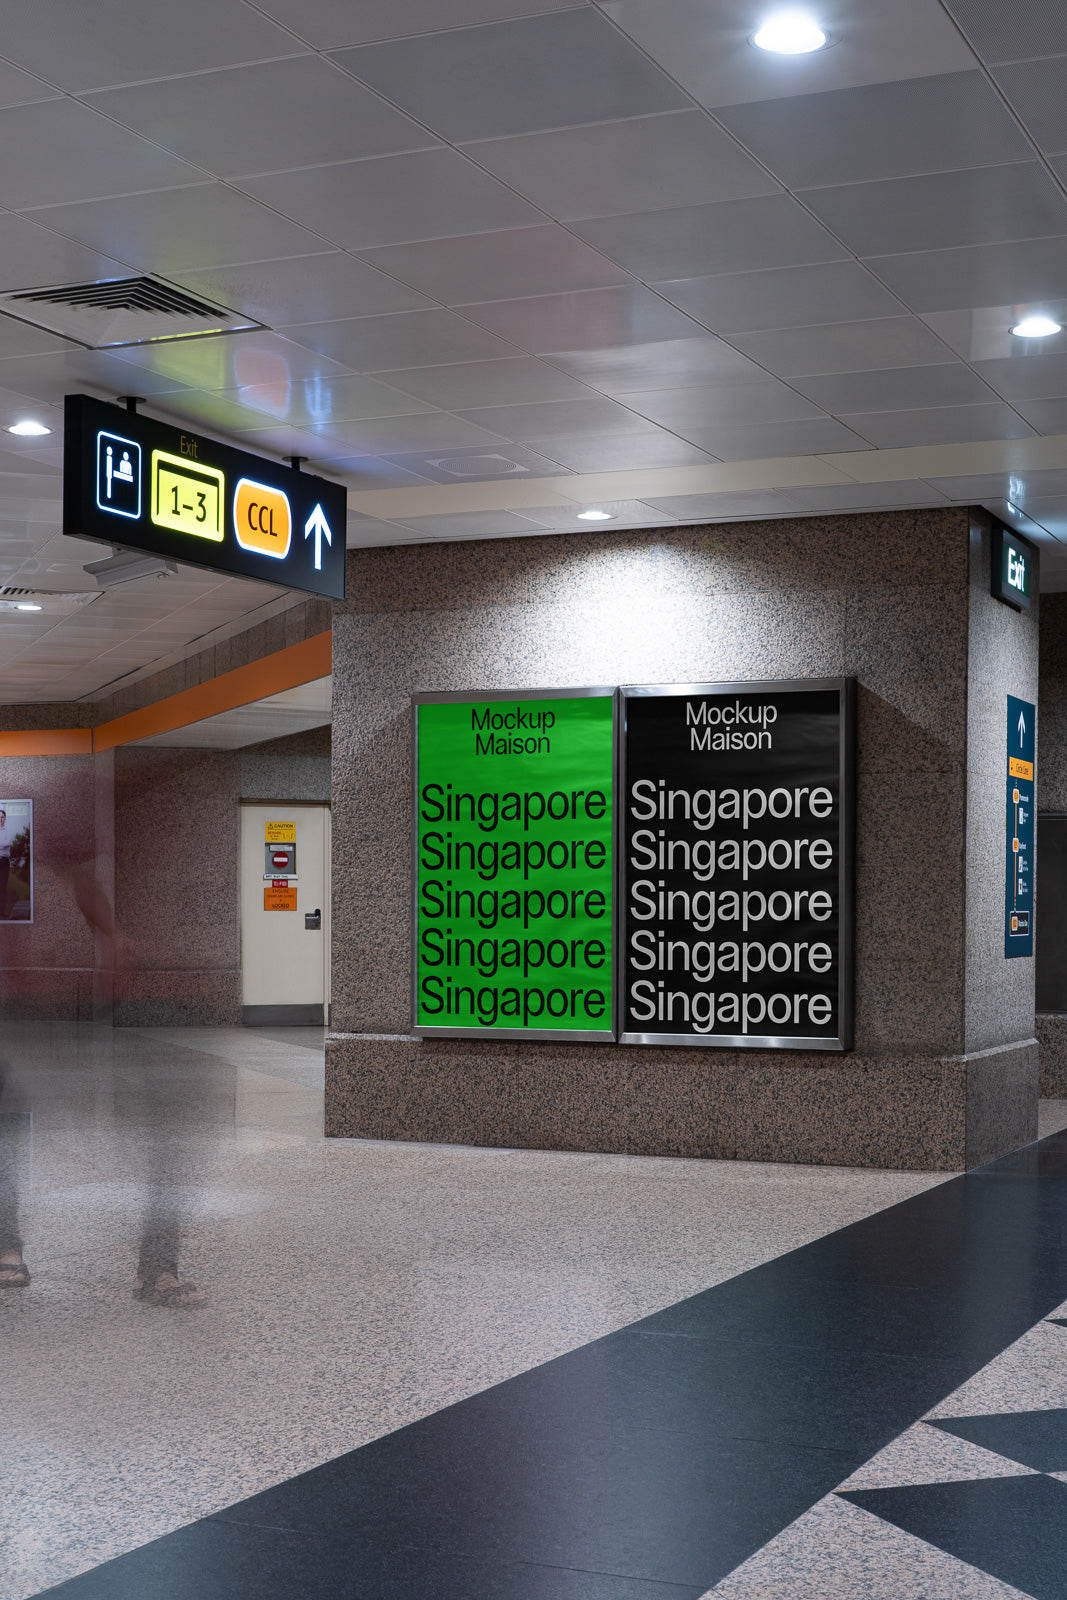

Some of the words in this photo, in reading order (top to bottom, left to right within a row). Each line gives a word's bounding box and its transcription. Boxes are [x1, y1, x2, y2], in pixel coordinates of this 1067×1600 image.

[180, 435, 199, 458] Exit
[171, 485, 207, 523] 1-3
[247, 502, 278, 537] CCL
[1007, 547, 1026, 592] Exit
[471, 706, 556, 735] Mockup
[686, 700, 778, 730] Mockup
[690, 726, 772, 751] Maison
[475, 732, 550, 756] Maison
[421, 783, 607, 832] Singapore
[630, 779, 833, 831] Singapore
[421, 831, 607, 880] Singapore
[630, 829, 833, 881] Singapore
[420, 879, 606, 929] Singapore
[630, 879, 833, 932] Singapore
[420, 927, 606, 978] Singapore
[630, 929, 833, 983] Singapore
[420, 975, 606, 1026] Singapore
[629, 979, 832, 1034] Singapore
